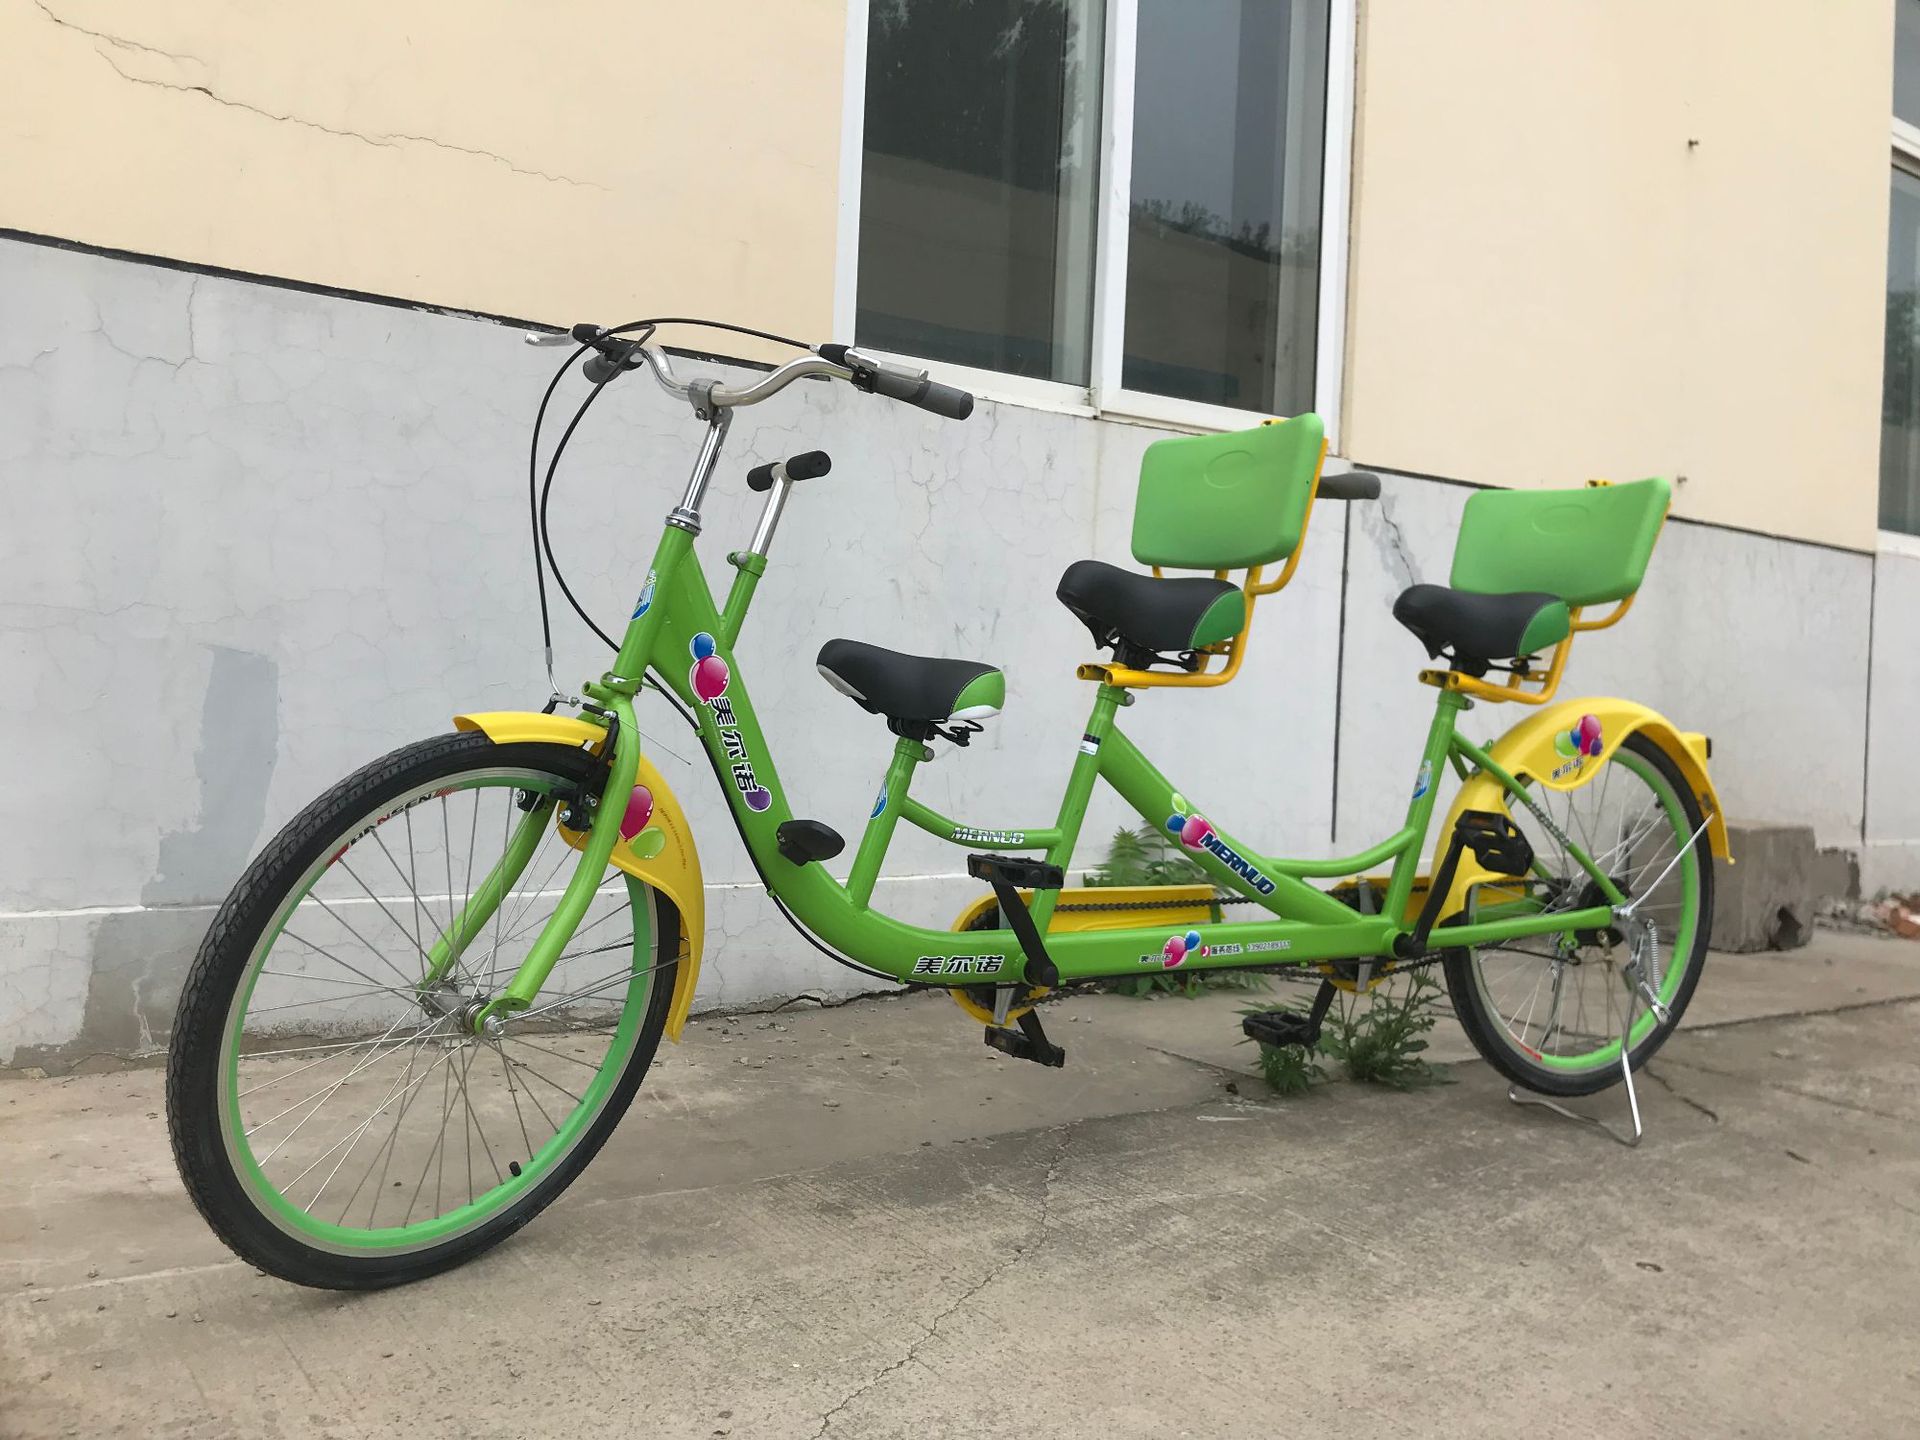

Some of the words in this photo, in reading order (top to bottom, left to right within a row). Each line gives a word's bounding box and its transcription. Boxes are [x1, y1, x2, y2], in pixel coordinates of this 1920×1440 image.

[709, 697, 759, 792] 美尔诺
[1200, 831, 1277, 896] MERNUO
[912, 955, 1005, 975] 美尔诺
